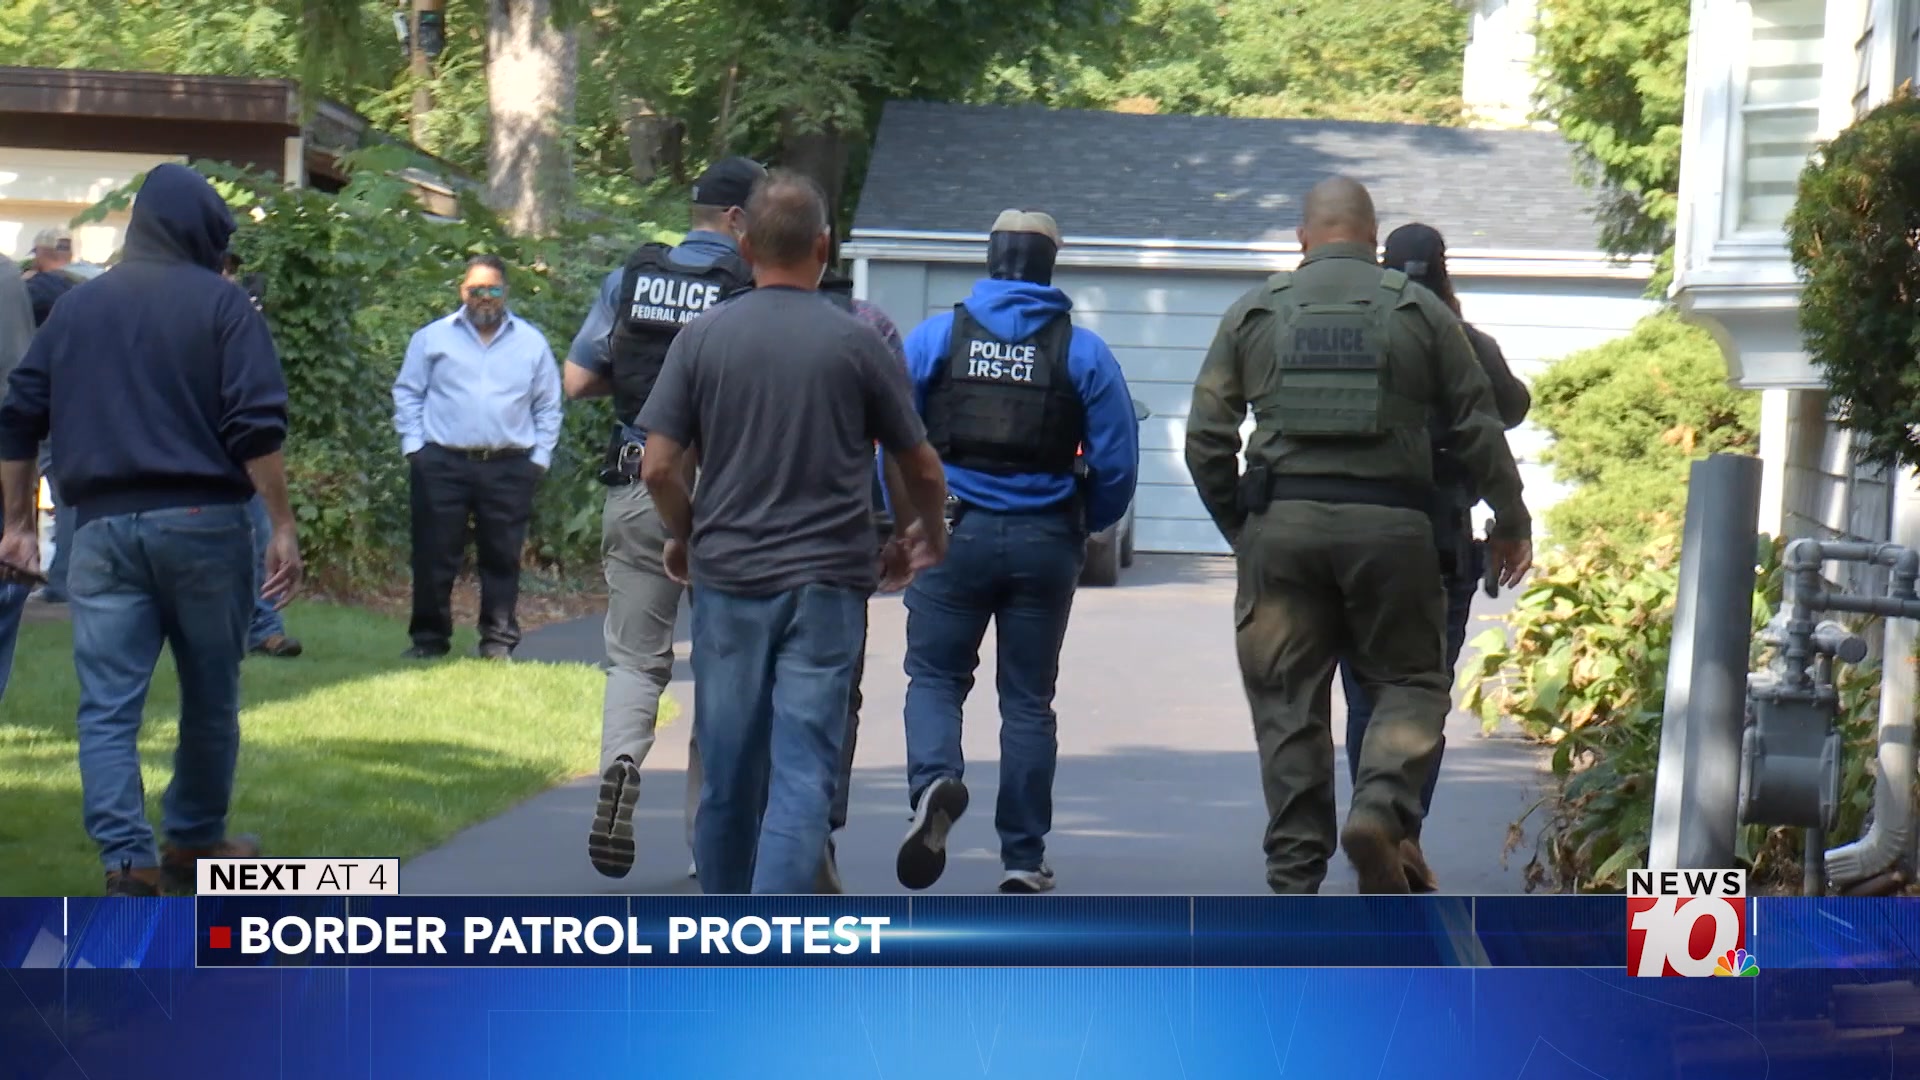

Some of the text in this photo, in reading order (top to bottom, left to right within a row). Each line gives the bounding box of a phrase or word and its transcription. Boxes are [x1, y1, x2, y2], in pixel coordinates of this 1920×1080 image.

[633, 276, 721, 310] POLICE
[631, 304, 676, 322] FEDERAL
[970, 340, 1035, 363] POLICE
[1295, 328, 1364, 352] POLICE
[968, 359, 1033, 381] IRS-CI
